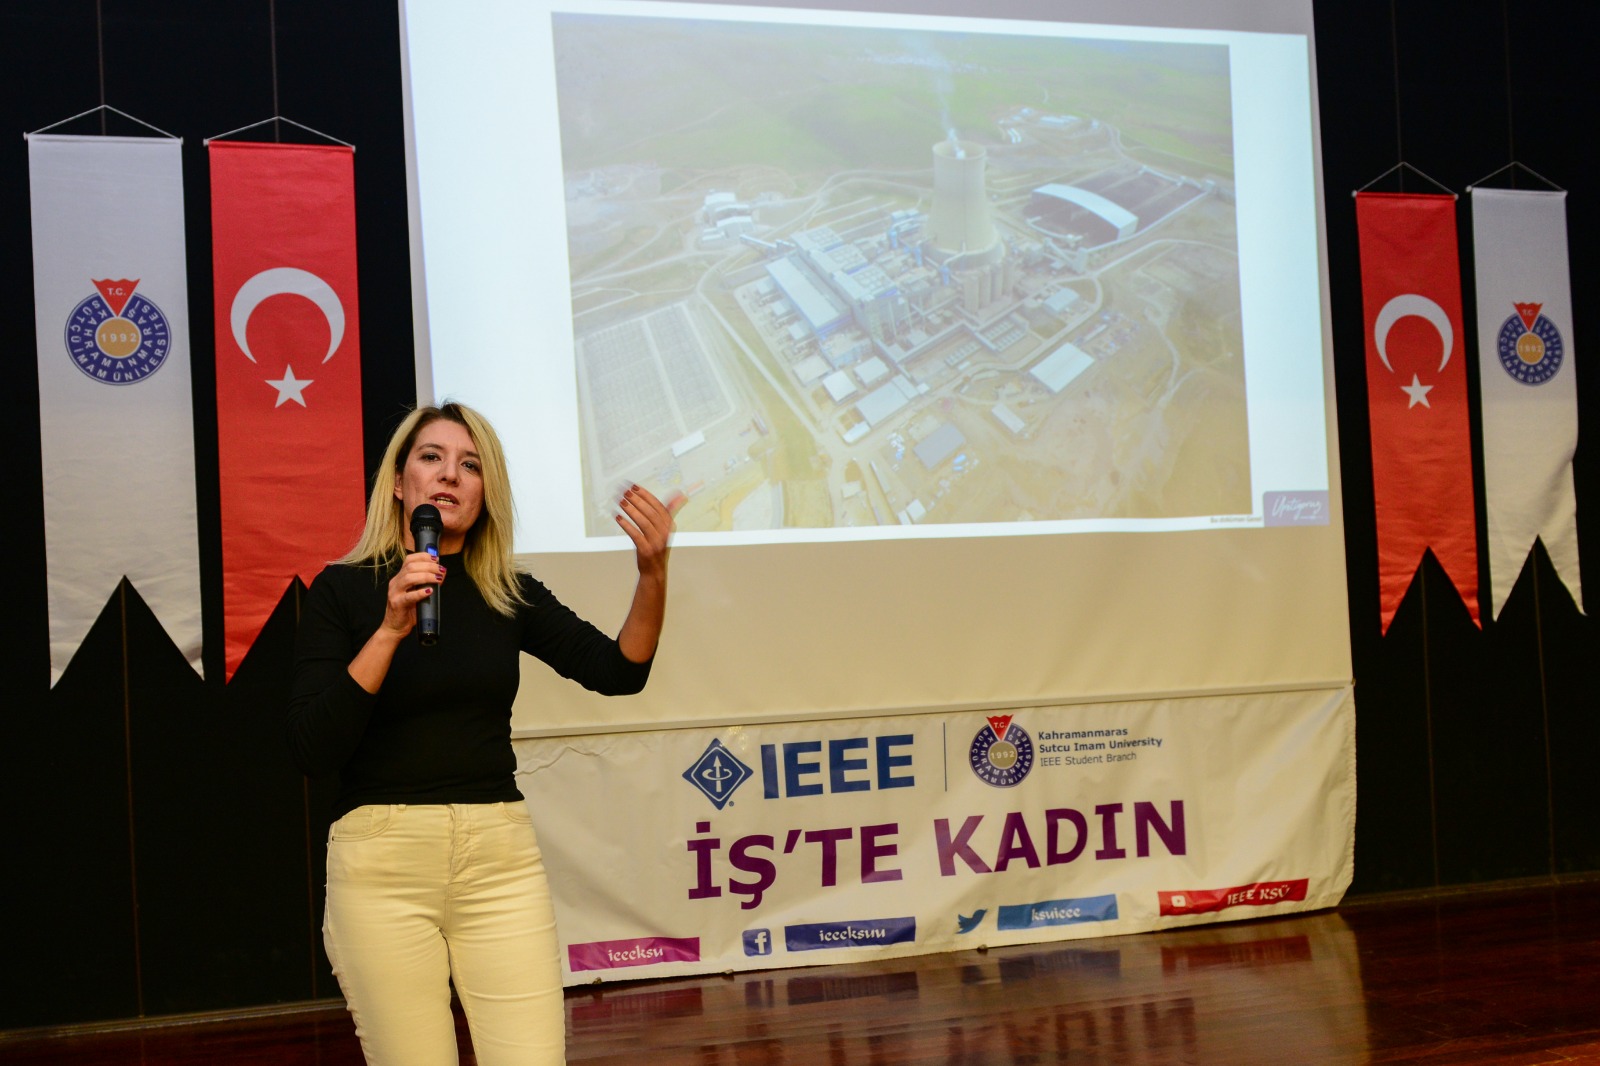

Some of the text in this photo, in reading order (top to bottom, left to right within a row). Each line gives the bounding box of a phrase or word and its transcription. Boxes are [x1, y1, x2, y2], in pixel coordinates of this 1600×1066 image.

[107, 287, 127, 296] T.C.
[101, 333, 137, 343] 1992
[1038, 728, 1128, 741] Kahramanmaras
[1040, 737, 1163, 753] Sutcu Imam University
[990, 750, 1015, 759] 1992
[1040, 751, 1137, 767] IEEE Student Branch
[761, 734, 915, 800] IEEE
[934, 800, 1187, 877] KADIN
[1227, 888, 1256, 905] IEEE
